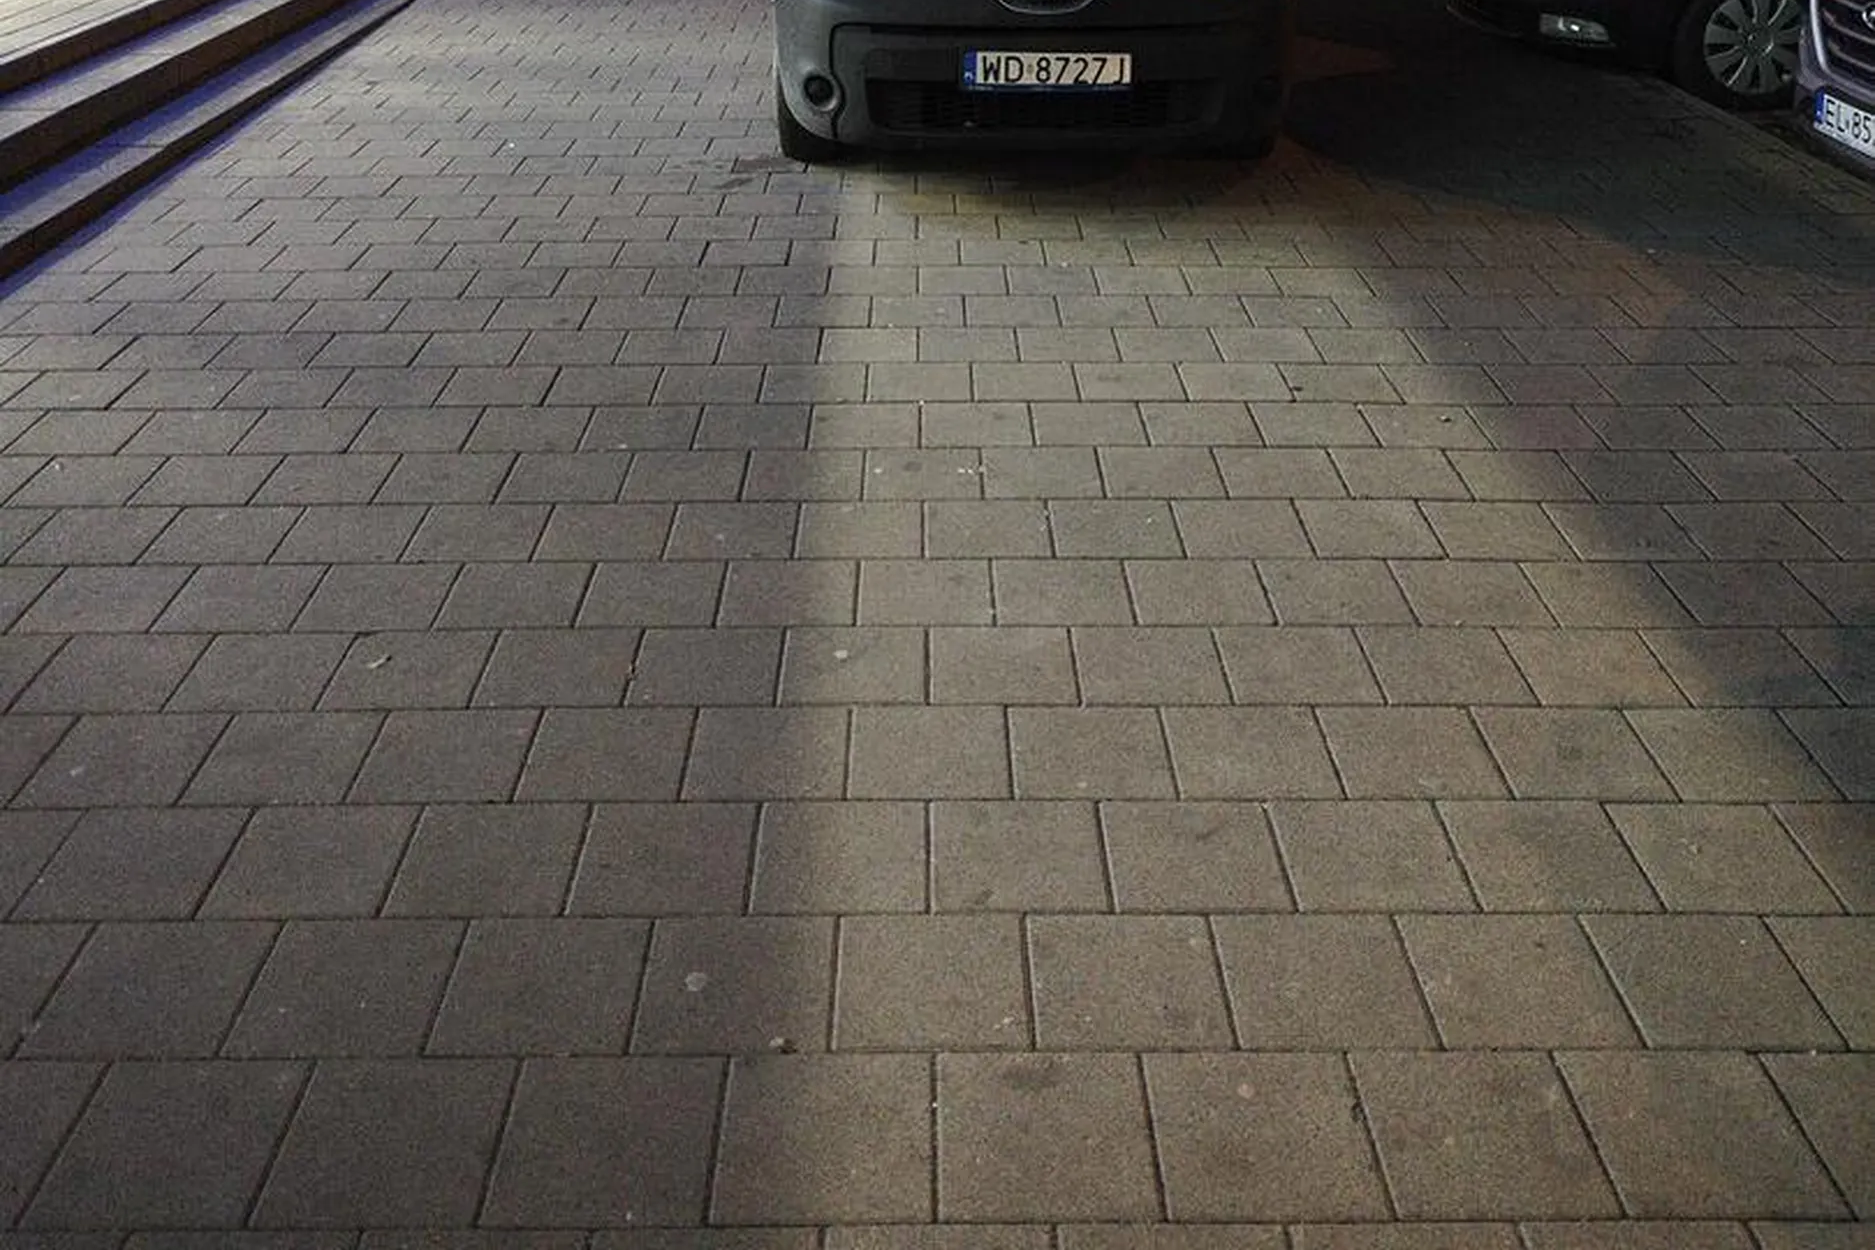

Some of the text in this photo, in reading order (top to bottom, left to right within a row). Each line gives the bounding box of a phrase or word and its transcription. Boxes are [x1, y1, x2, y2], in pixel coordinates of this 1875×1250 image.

[982, 55, 1125, 85] WD 8727J
[1825, 98, 1875, 146] EL 85
